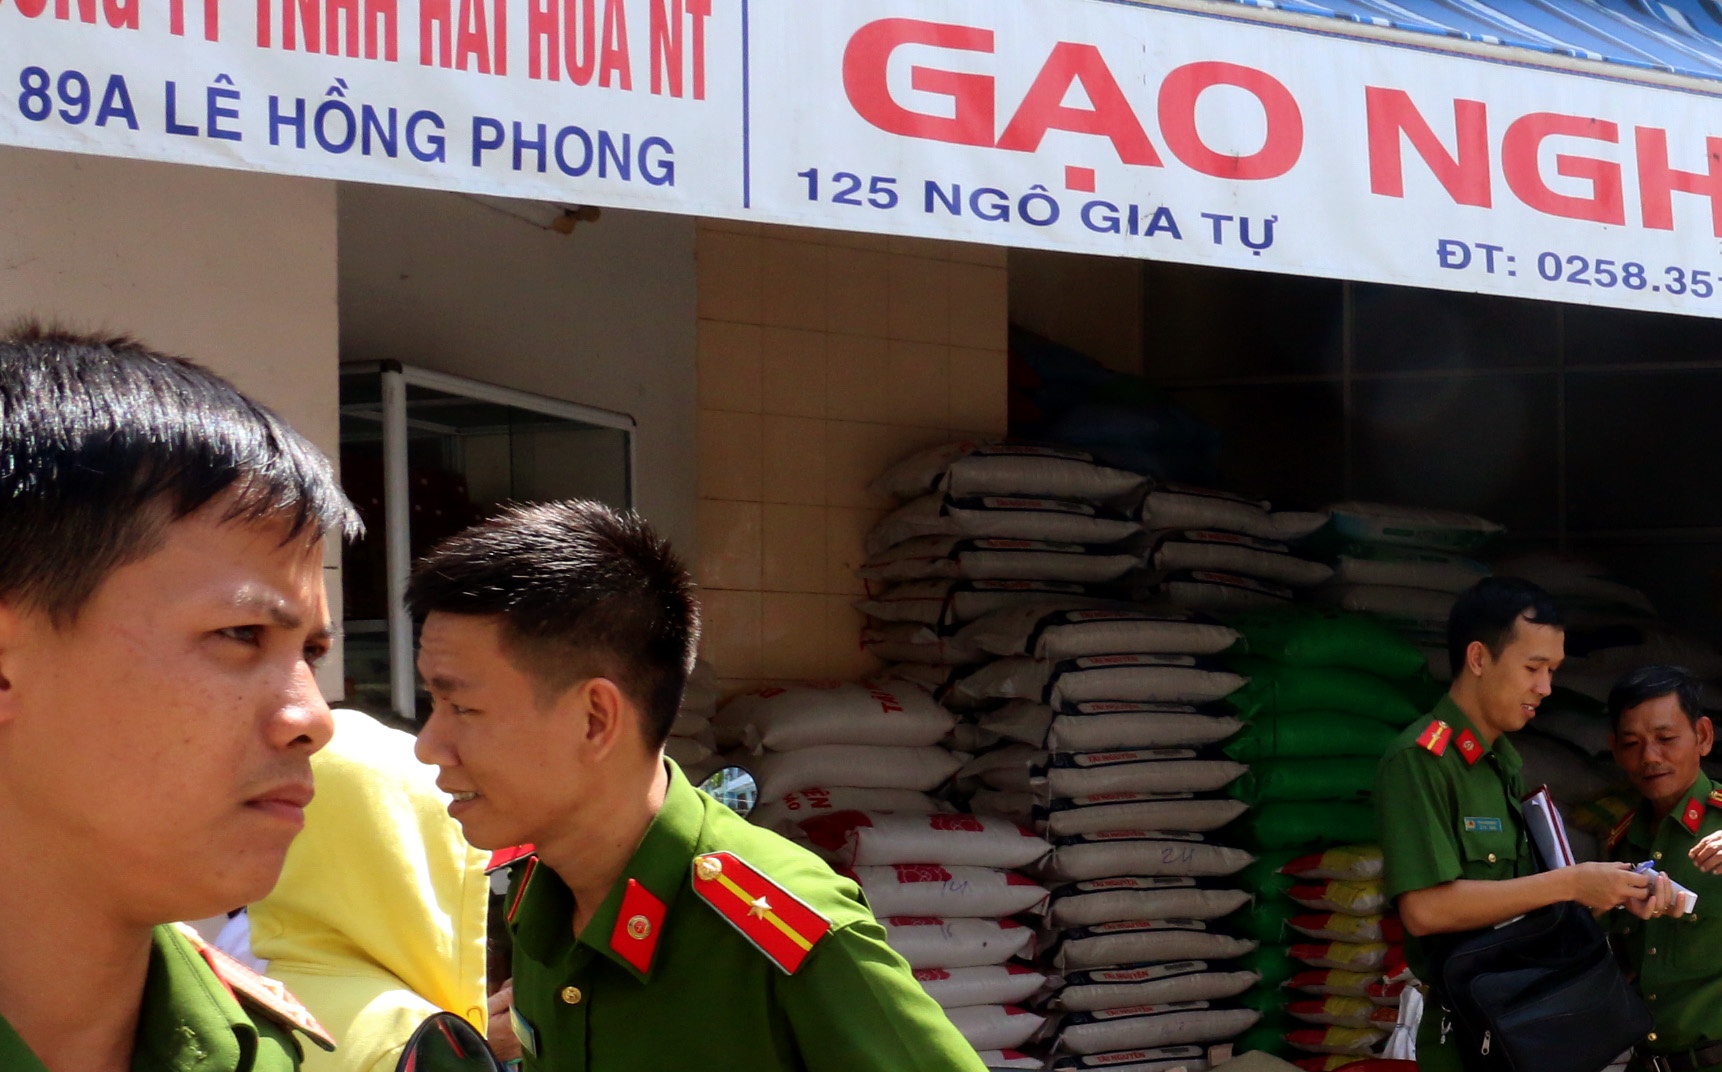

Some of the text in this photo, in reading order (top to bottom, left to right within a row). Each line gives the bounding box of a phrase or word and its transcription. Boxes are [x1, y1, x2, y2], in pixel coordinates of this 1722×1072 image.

[649, 0, 713, 101] NT
[18, 66, 676, 187] 89A LÊ HỒNG PHONG
[842, 17, 1304, 193] GẠO
[797, 168, 1279, 257] 125 NGÔ GIA TỰ
[1436, 238, 1518, 278] ĐT:
